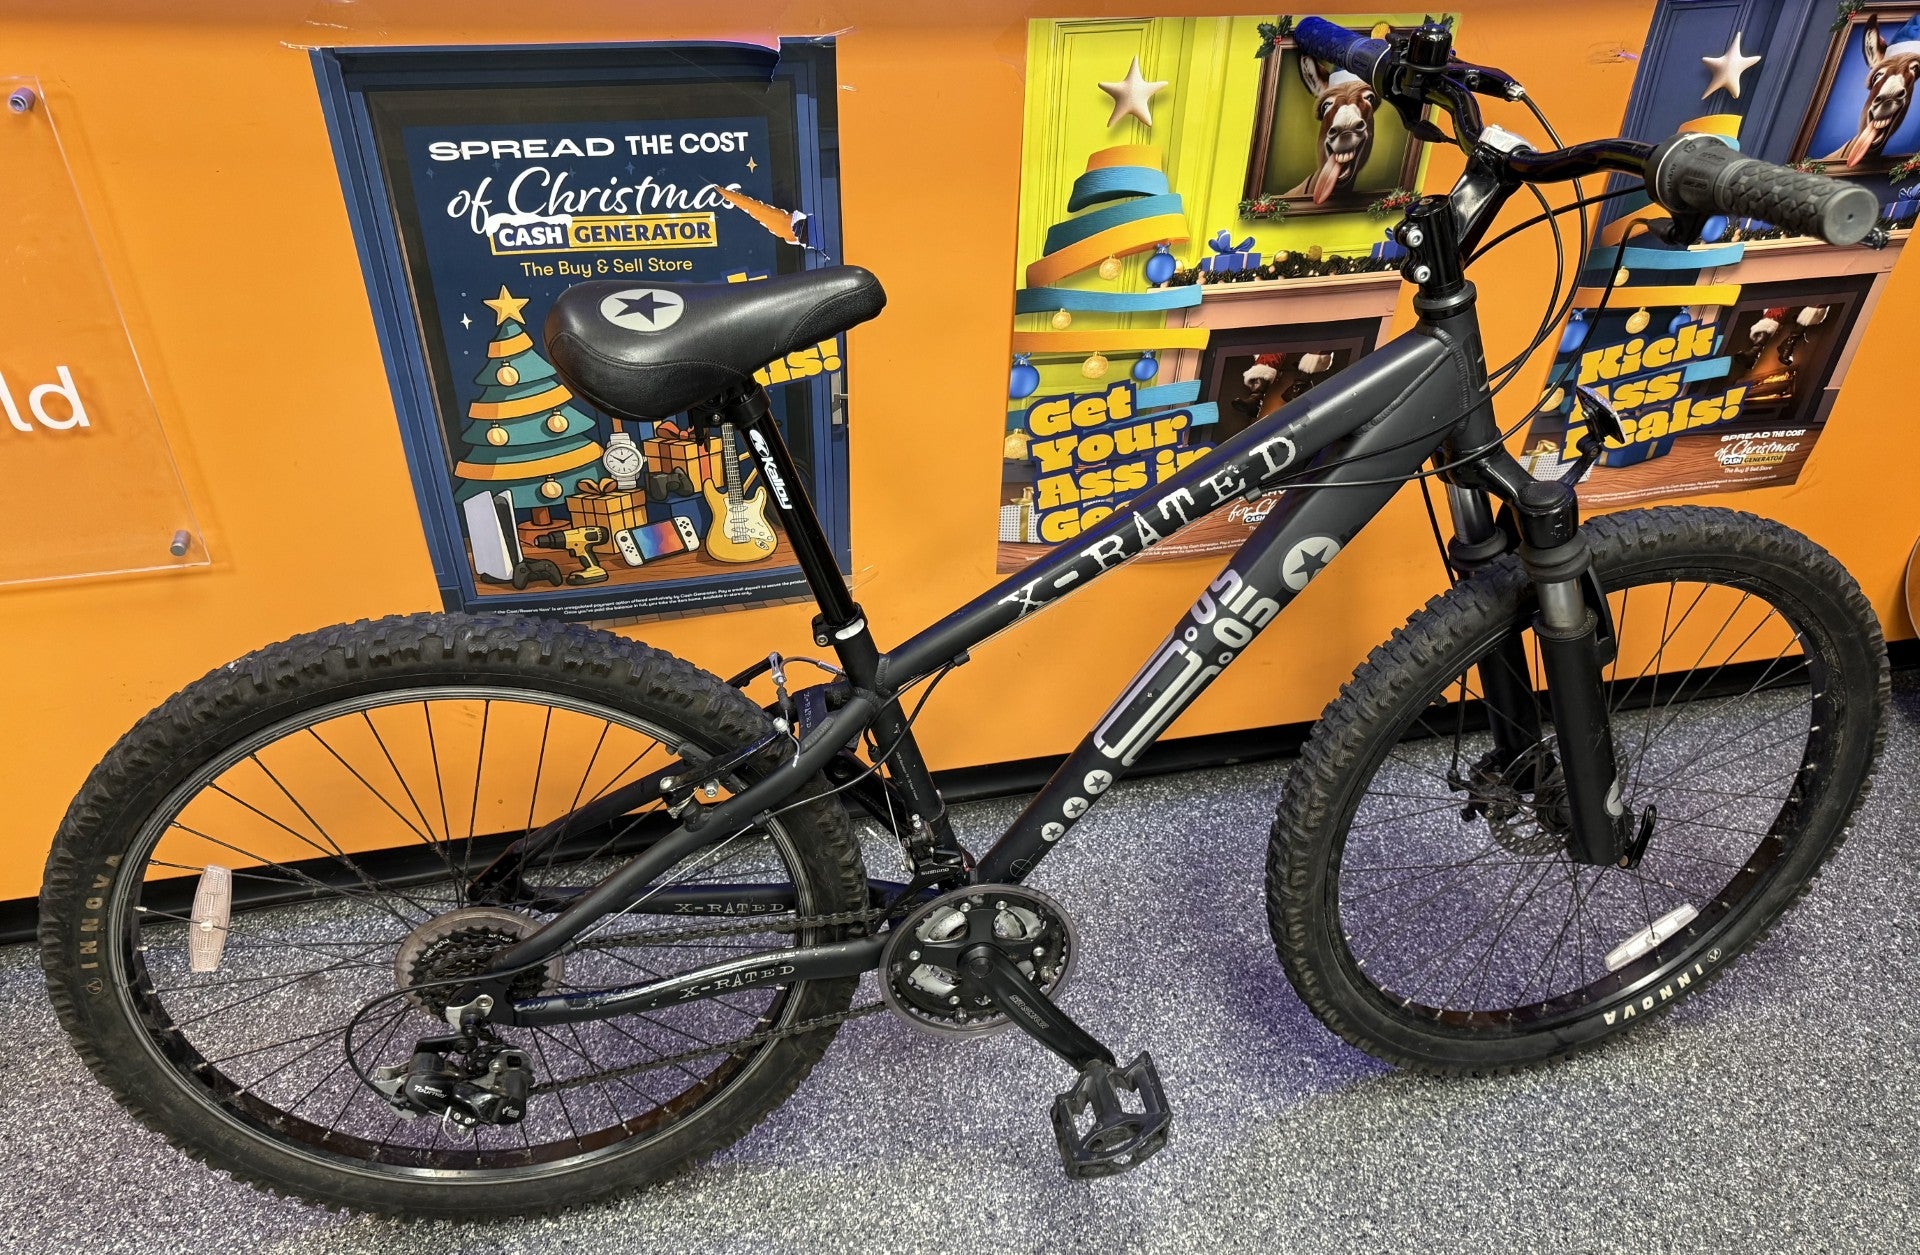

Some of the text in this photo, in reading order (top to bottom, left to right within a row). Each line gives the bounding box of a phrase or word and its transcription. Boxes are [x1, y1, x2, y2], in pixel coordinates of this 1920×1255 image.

[428, 131, 749, 162] SPREAD THE COST
[446, 166, 742, 234] of Christmas
[499, 221, 711, 248] CASH GENERATOR
[520, 257, 692, 278] The Buy & Sell Store
[1577, 324, 1716, 386] Kick
[1029, 385, 1132, 437] Get
[1032, 414, 1188, 473] Your
[1714, 440, 1800, 462] of Christmas
[1721, 429, 1806, 442] SPREAD THE COST
[1723, 454, 1783, 465] CASH GENERATOR
[761, 457, 793, 510] Kalloy
[1037, 461, 1148, 510] Ass
[997, 436, 1297, 619] X-RATED
[1228, 504, 1254, 523] for
[79, 853, 124, 970] INNOVA
[674, 902, 785, 914] X-RATED
[679, 965, 795, 1000] X-RATED
[1603, 963, 1704, 1026] INNOVA
